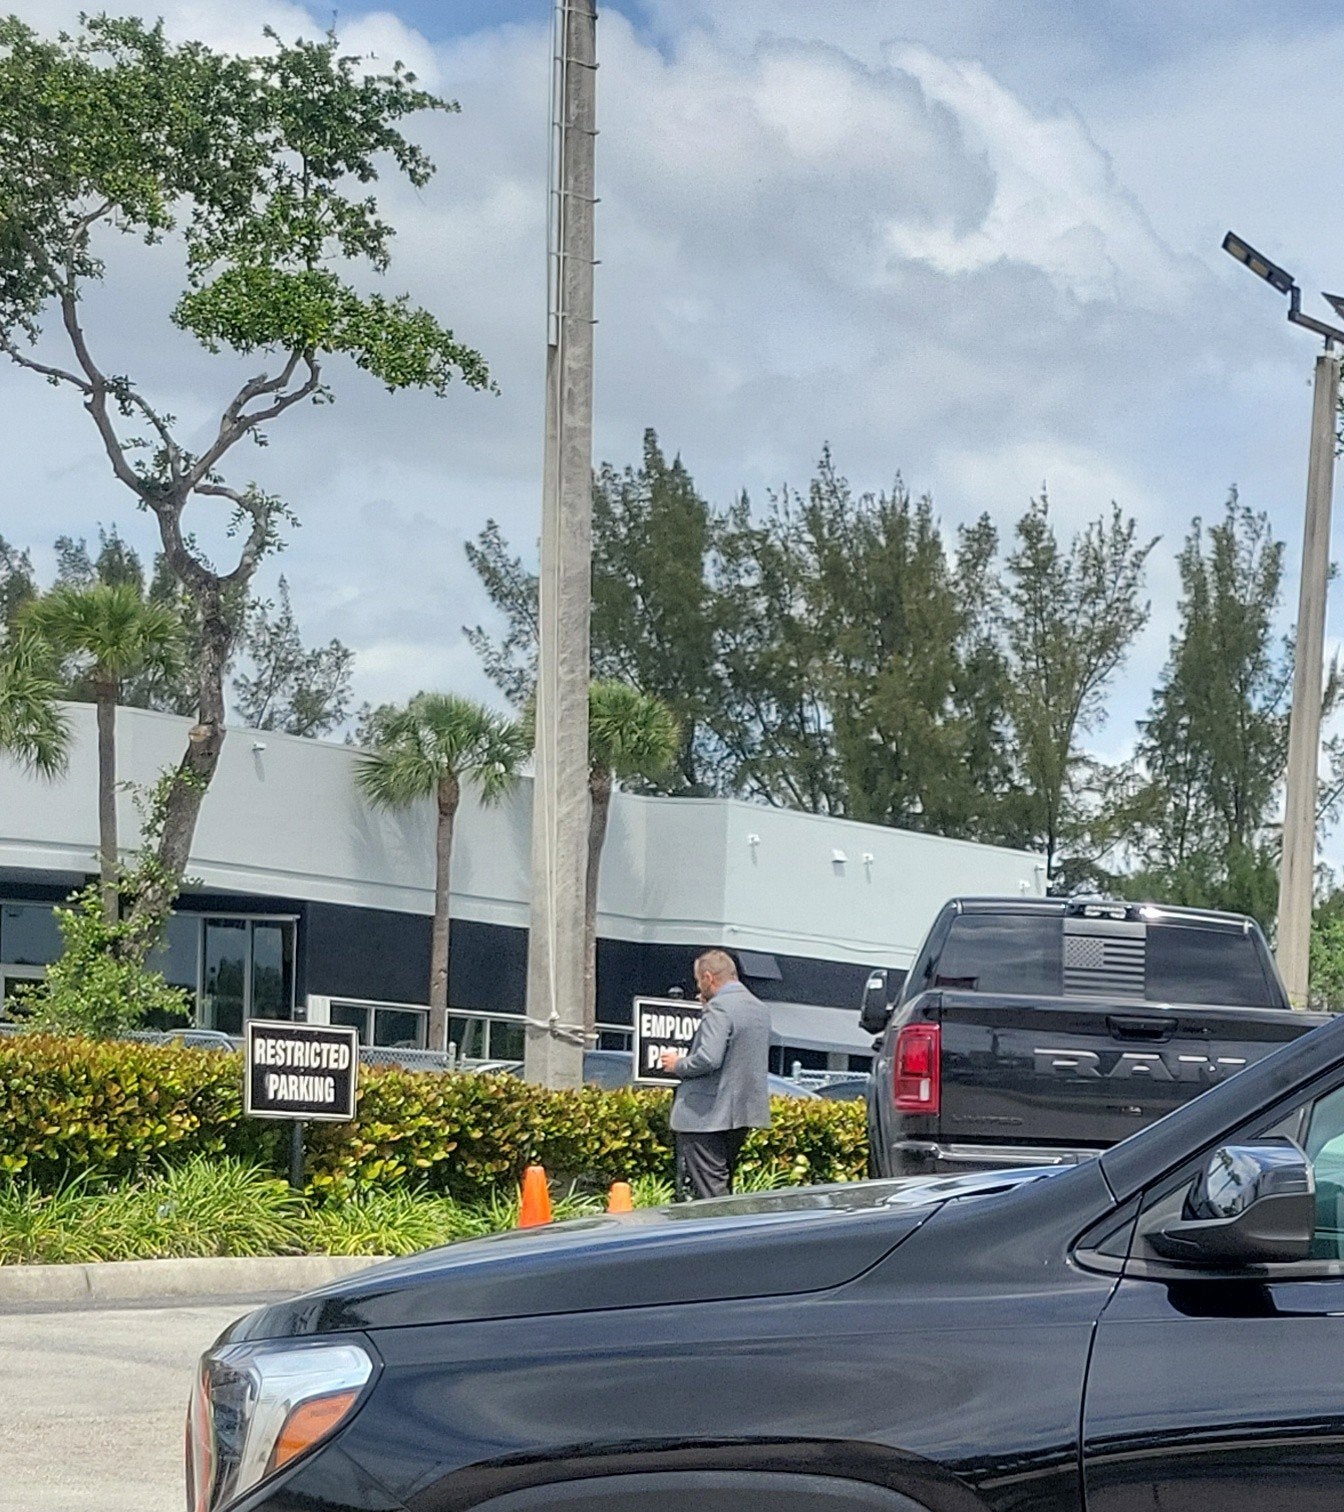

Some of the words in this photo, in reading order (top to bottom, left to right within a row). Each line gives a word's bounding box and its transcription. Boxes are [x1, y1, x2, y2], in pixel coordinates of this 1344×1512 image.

[641, 1013, 703, 1042] EMPLOY
[254, 1037, 351, 1070] RESTRICTED
[1033, 1048, 1248, 1083] RAM
[267, 1073, 335, 1103] PARKING
